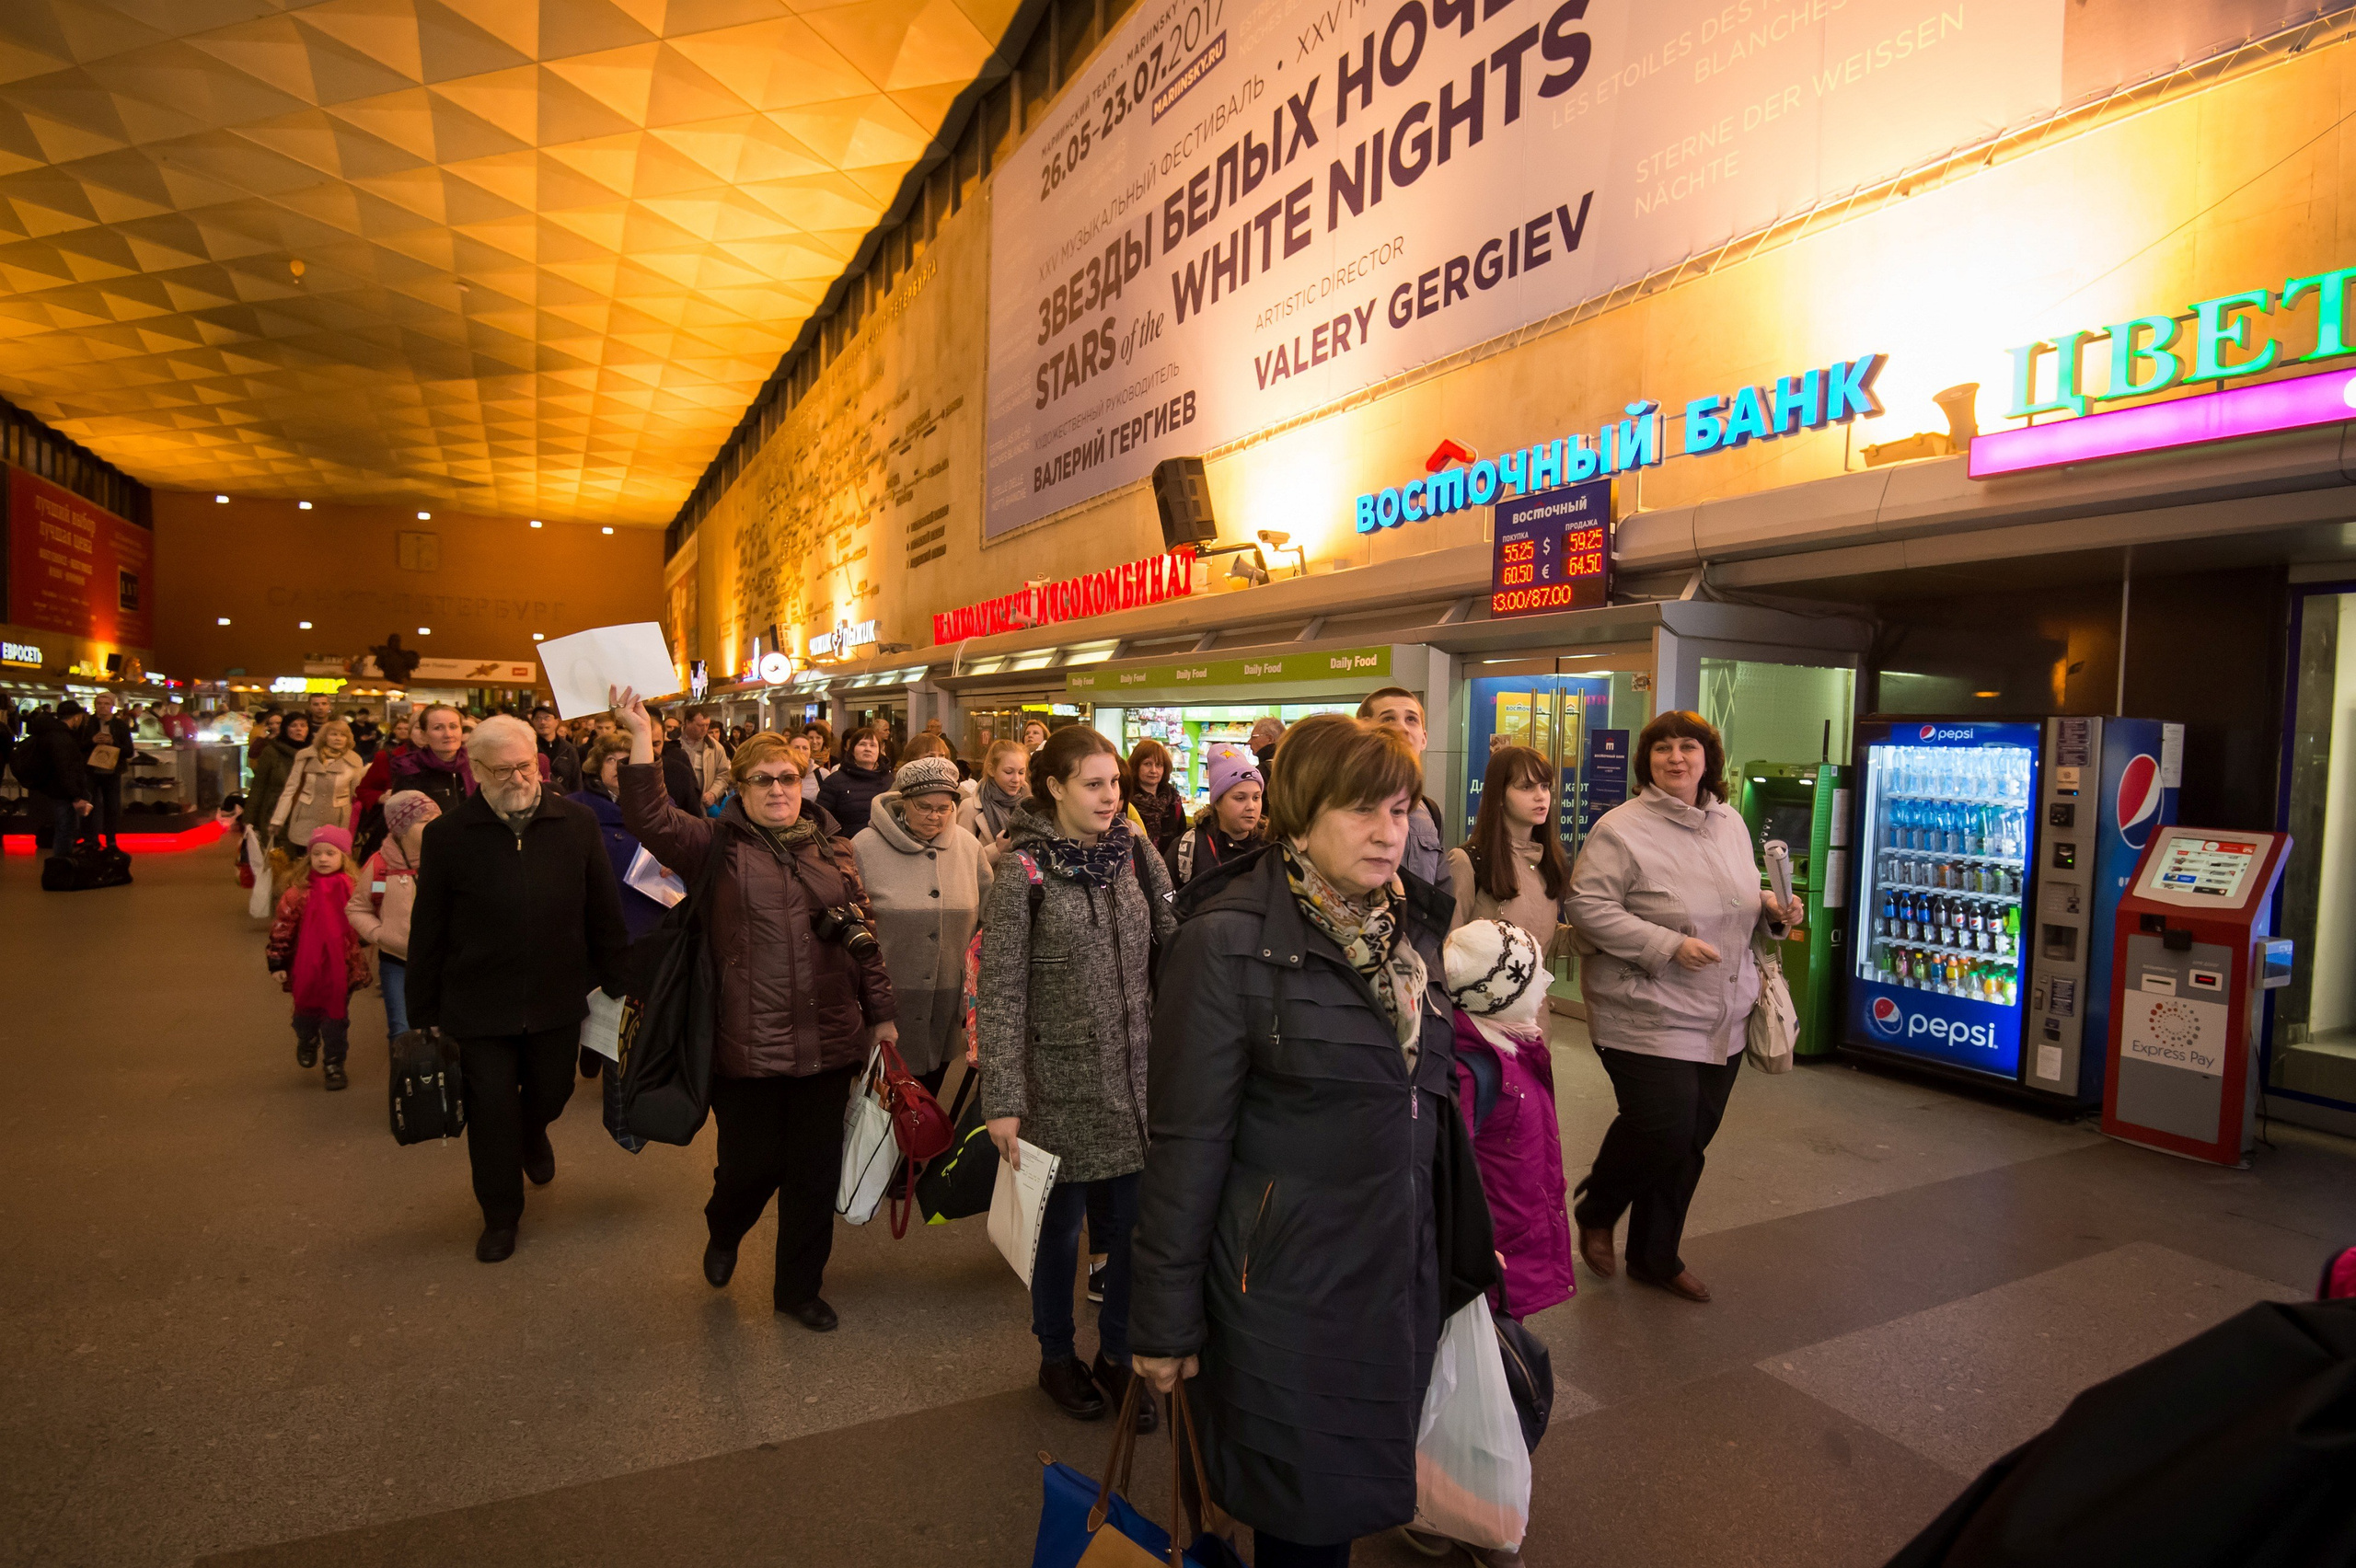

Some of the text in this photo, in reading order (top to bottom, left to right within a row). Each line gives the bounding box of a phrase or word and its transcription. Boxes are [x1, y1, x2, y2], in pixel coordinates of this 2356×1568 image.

[1092, 67, 1118, 100] ТЕАТР
[1126, 2, 1178, 66] MARIINSKY
[1152, 39, 1224, 118] MARIINSKY.RU
[1552, 0, 1752, 131] LES ETOILES DES
[1635, 2, 1964, 183] STERNE DER WEISSEN
[1061, 162, 1156, 264] МУЗЫКАЛЬНЫЙ
[1161, 74, 1265, 177] ФЕСТИВАЛЬ
[1296, 0, 1342, 64] XXV
[1034, 0, 1591, 410] STARS of the WHITE NIGHTS
[1037, 211, 1152, 346] ЗВЕЗДЫ
[1162, 74, 1321, 256] БЕЛЫХ
[1634, 150, 1740, 219] NÄCHTE
[1253, 235, 1405, 334] ARTISTIC DIRECTOR
[1253, 190, 1595, 391] VALERY GERGIEV
[1034, 361, 1180, 451] ХУДОЖЕСТВЕННЫЙ РУКОВОДИТЕЛЬ
[1685, 353, 1885, 455] БАНК
[1034, 389, 1196, 494] ВАЛЕРИЙ ГЕРГИЕВ
[1502, 518, 1599, 543] ПОКУПКА ПРОДАЖА
[1504, 528, 1603, 563] 55.25 $ 59.25
[1036, 552, 1195, 626] МЯСОКОМБИНАТ
[1503, 552, 1601, 585] 60.50 € 64.50
[2, 641, 43, 663] ЕВРОСЕТЬ
[1120, 673, 1147, 684] Daily Food
[1176, 668, 1207, 680] Daily Food
[1244, 662, 1282, 676] Daily Food
[1330, 653, 1378, 671] Daily Food
[1937, 728, 1974, 741] pepsi
[1908, 1013, 1994, 1048] pepsi
[2131, 1039, 2215, 1069] Express Pay
